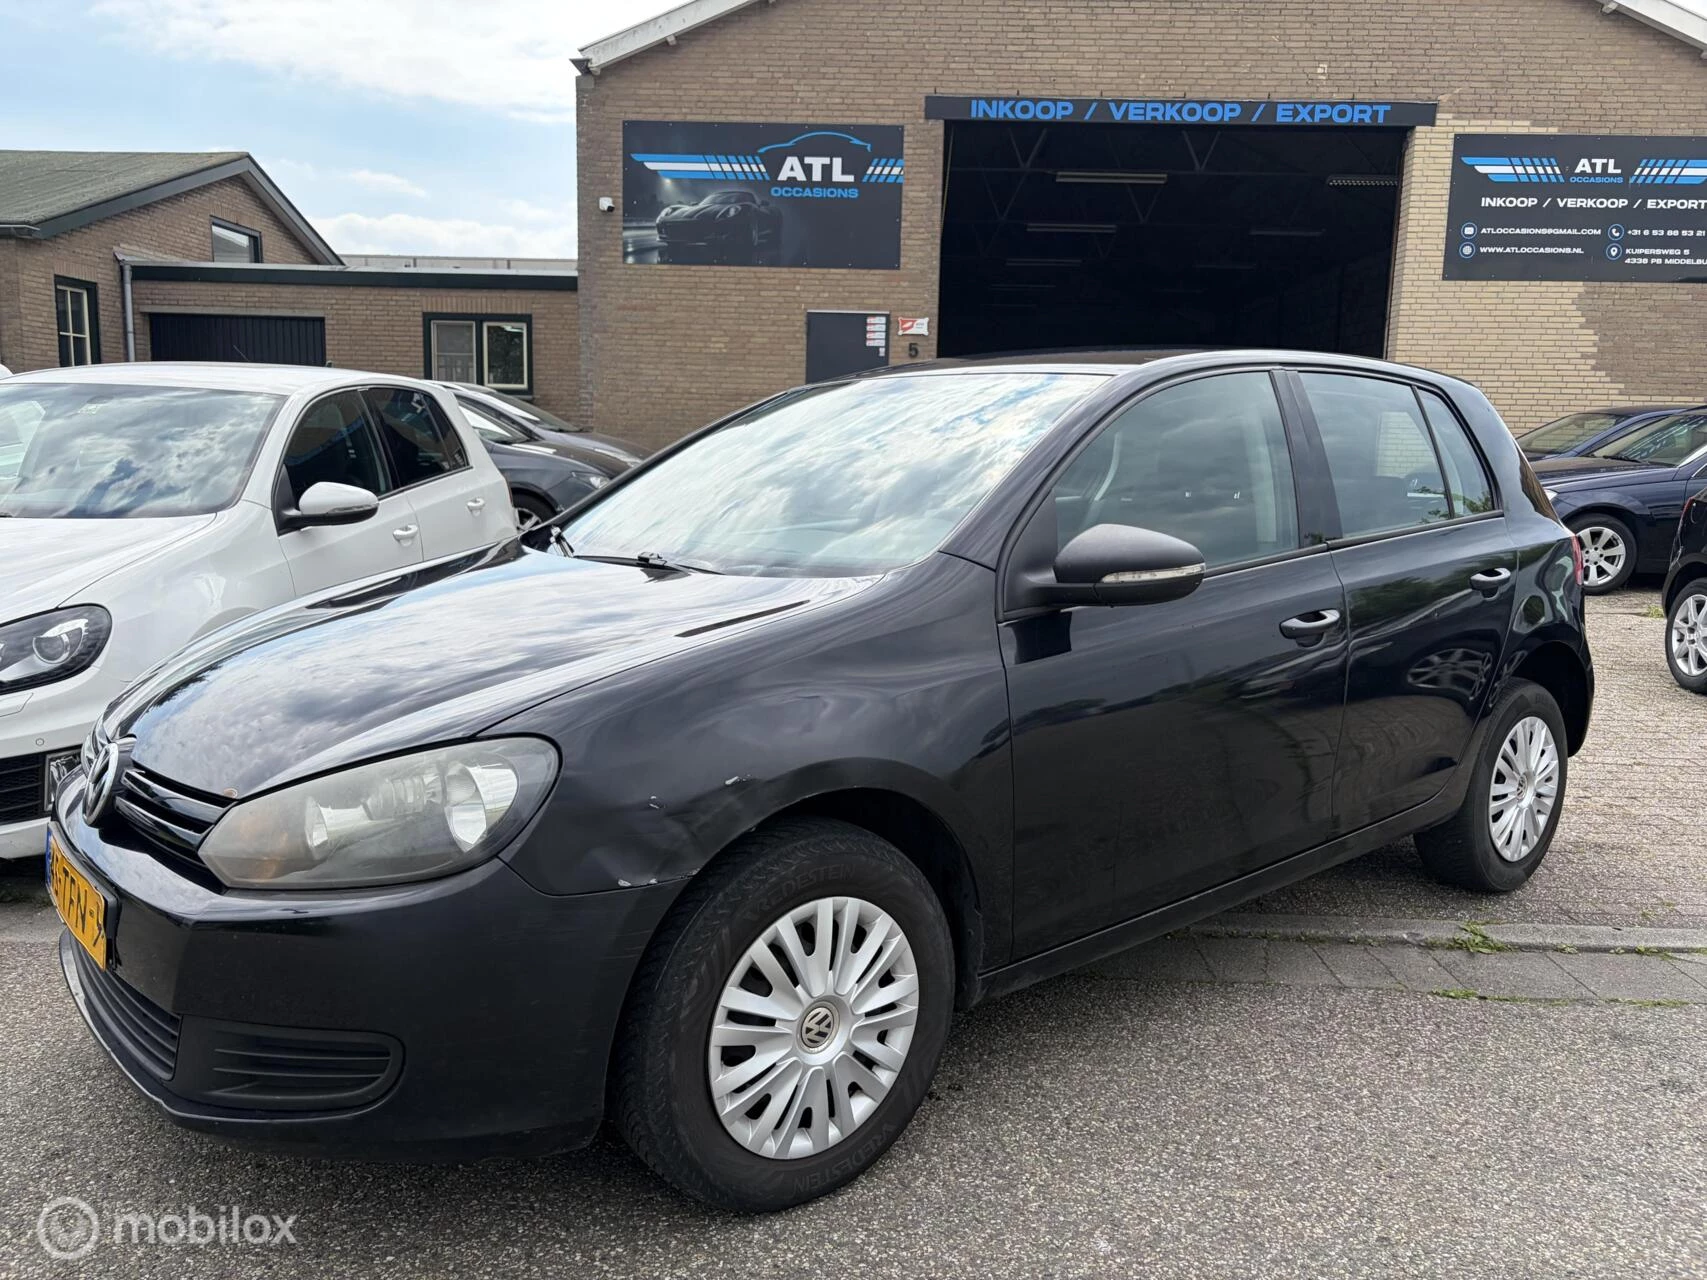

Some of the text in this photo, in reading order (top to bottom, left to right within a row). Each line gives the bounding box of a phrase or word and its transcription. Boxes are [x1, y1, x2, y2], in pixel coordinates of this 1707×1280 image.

[970, 100, 1392, 124] INKOOP / VERKOOP / EXPORT
[777, 156, 855, 183] ATL
[1574, 158, 1622, 174] ATL
[1569, 176, 1624, 184] OCCASIONS
[770, 186, 859, 199] OCCASIONS
[1481, 197, 1707, 210] INKOOP / VERKOOP / EXPORT
[908, 342, 919, 357] 5
